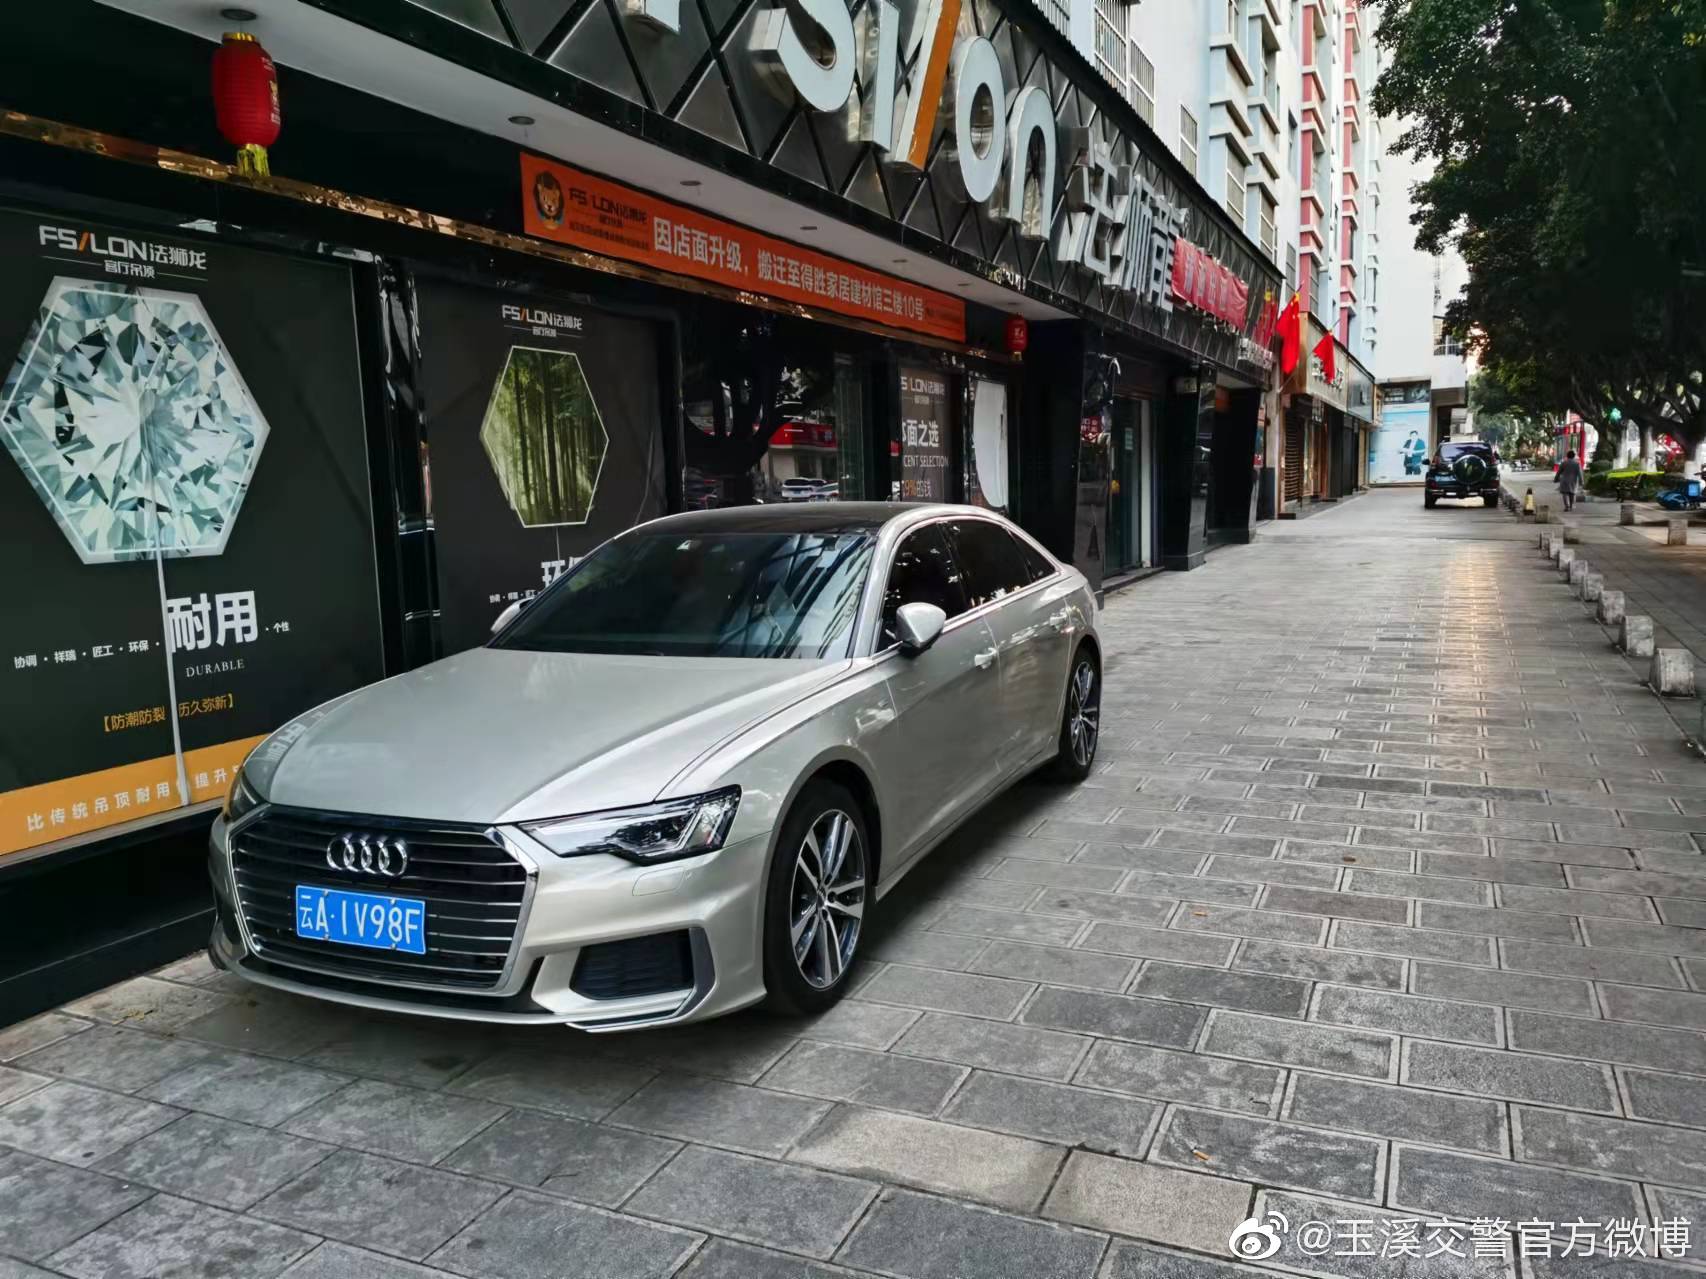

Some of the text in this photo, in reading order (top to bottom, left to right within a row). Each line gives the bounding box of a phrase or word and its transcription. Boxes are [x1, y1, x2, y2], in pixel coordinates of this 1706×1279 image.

[128, 639, 149, 653] 环保
[166, 590, 259, 653] 耐用
[185, 659, 245, 677] DURABLE
